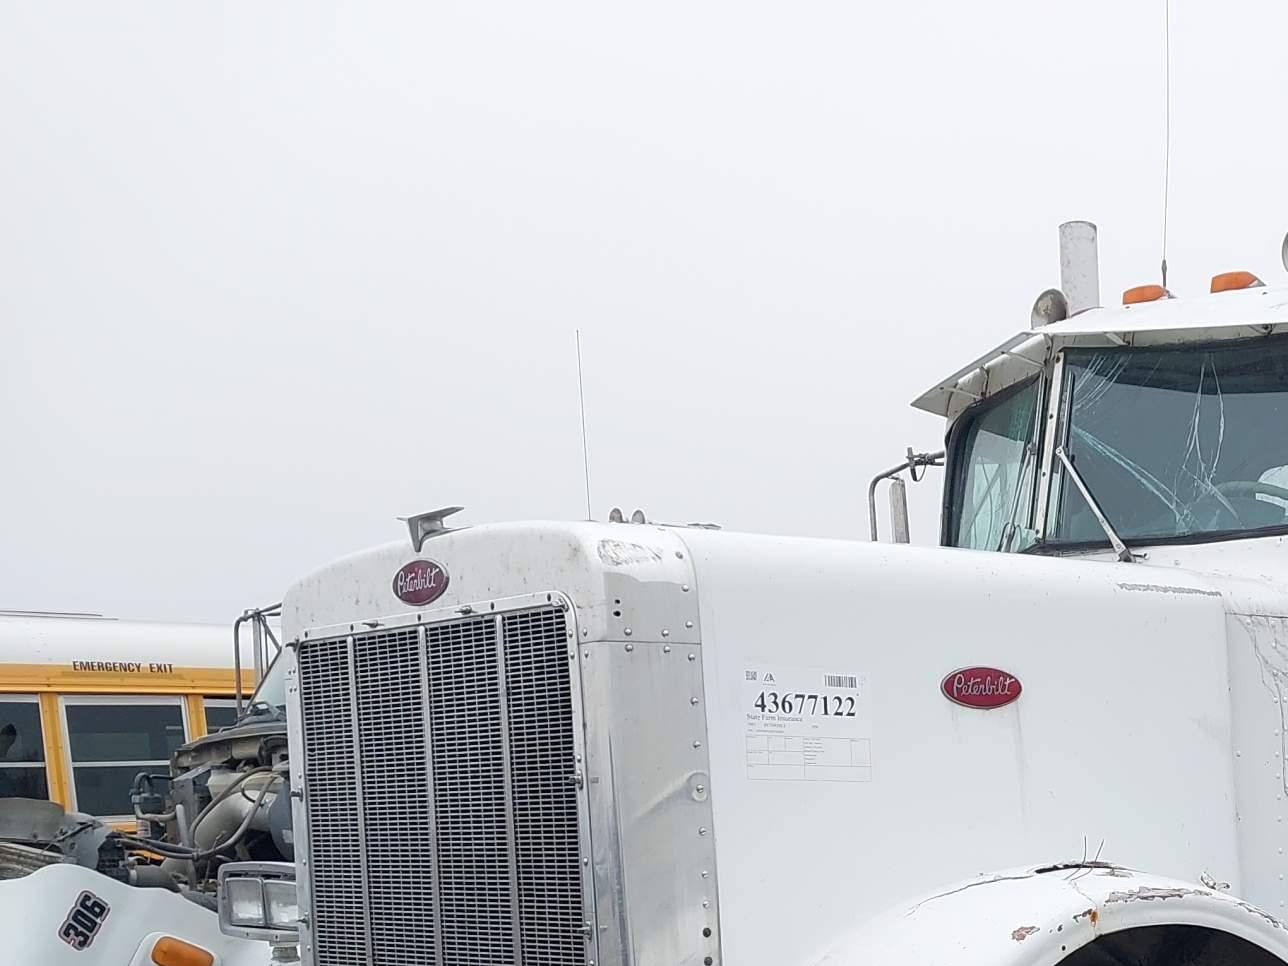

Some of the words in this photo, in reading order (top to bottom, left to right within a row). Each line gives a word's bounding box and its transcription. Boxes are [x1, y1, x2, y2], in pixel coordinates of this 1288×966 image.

[397, 567, 440, 597] Peterbilt
[72, 660, 142, 673] EMERGENCY
[149, 662, 174, 674] EXIT
[953, 673, 1015, 698] Peterbilt
[754, 690, 857, 717] 43677122
[60, 890, 110, 950] 306
